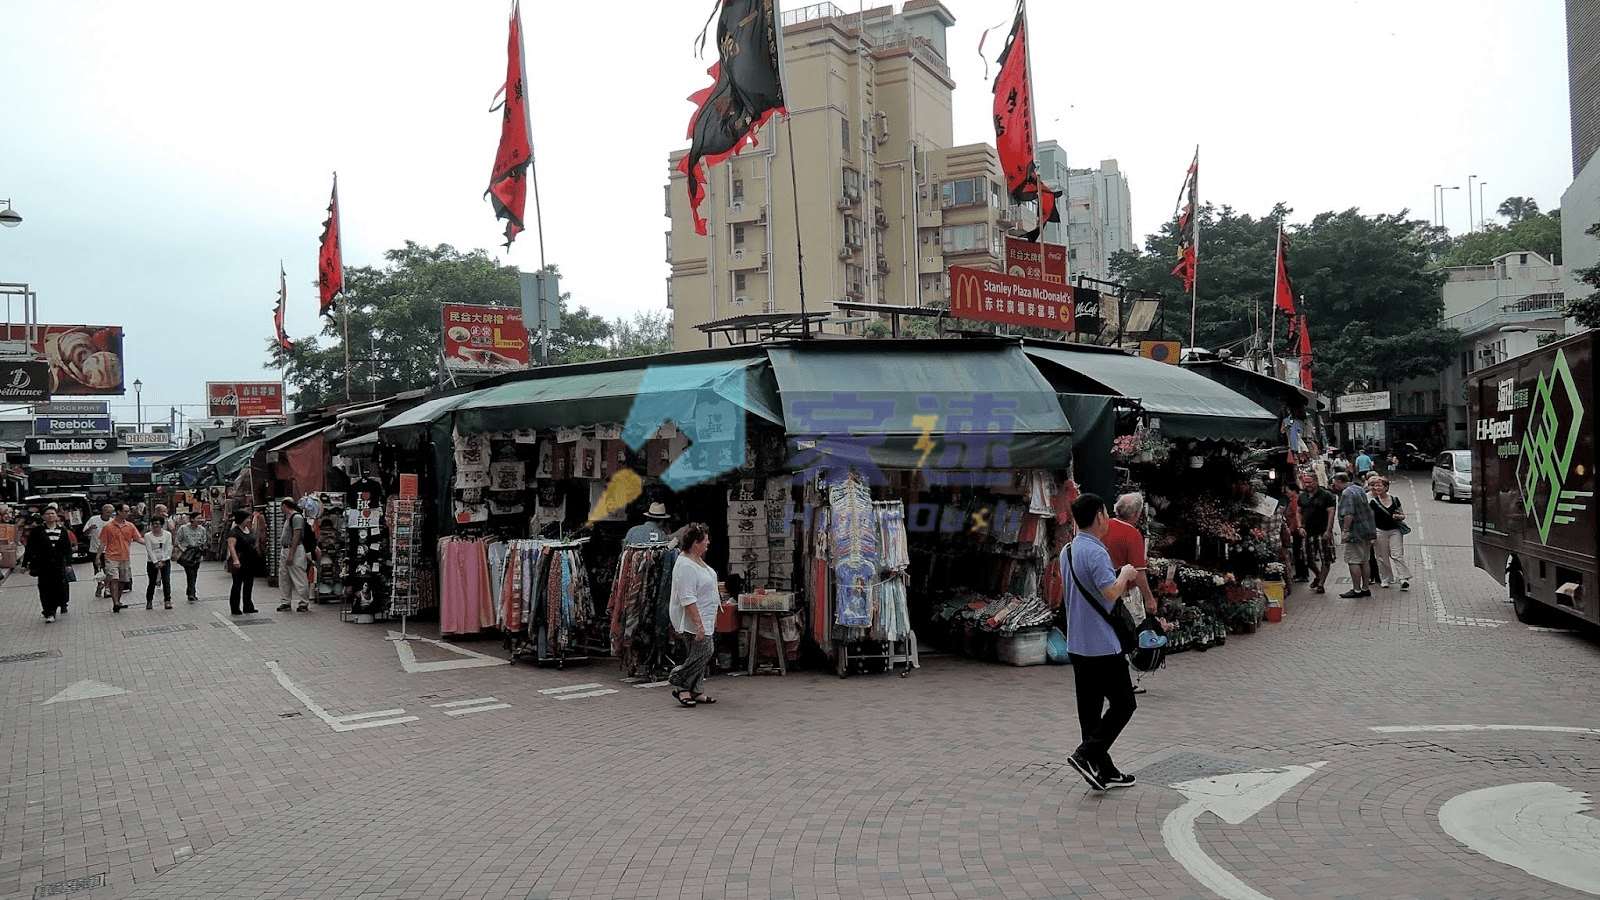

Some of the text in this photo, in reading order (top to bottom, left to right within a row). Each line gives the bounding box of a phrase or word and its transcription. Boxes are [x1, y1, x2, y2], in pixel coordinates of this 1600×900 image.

[983, 279, 1072, 304] Stanley Plaza McDonald's
[984, 296, 1056, 320] 赤柱廣場麥當勞
[449, 311, 504, 325] 民益大牌檔
[49, 419, 96, 429] Reebok
[1476, 414, 1514, 445] Hi-Speed
[36, 438, 93, 451] Timberland
[357, 491, 363, 501] I
[739, 491, 755, 501] HK
[357, 500, 371, 510] HK
[357, 518, 371, 527] HK
